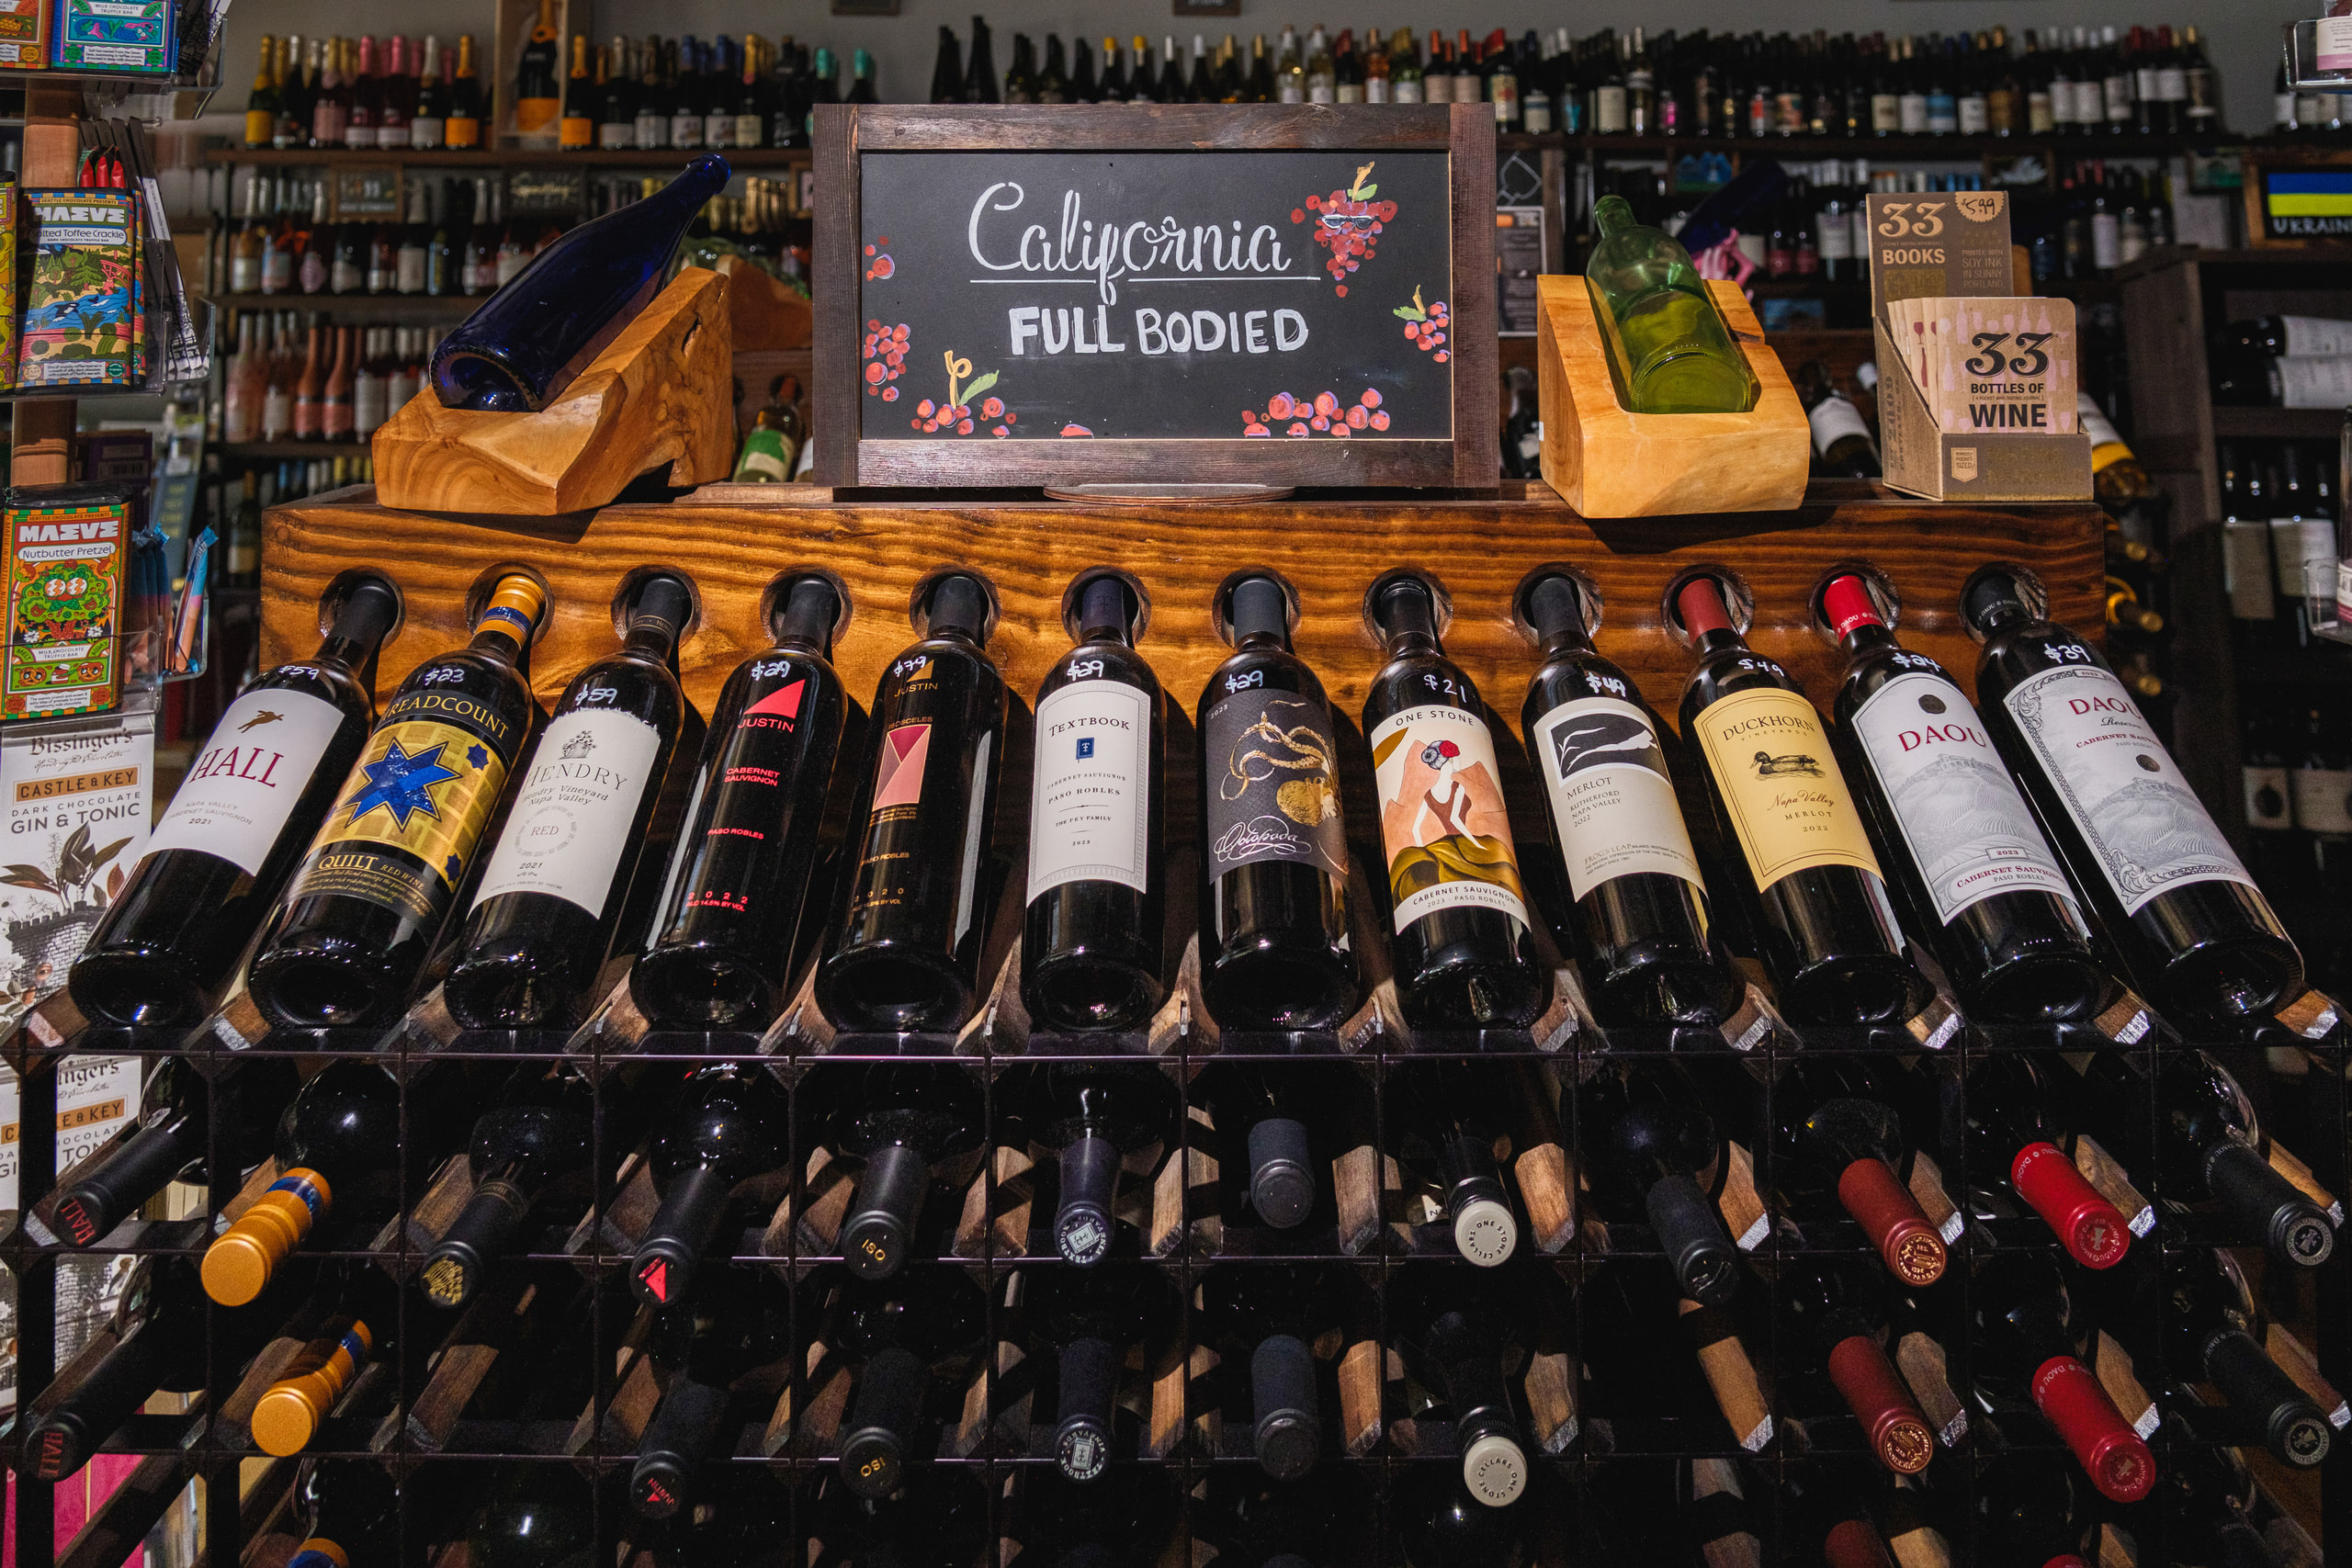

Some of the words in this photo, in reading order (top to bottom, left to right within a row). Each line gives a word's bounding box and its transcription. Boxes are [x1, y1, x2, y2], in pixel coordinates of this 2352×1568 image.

[34, 207, 124, 223] MAEVE
[1878, 202, 1949, 238] 33
[63, 229, 91, 237] Toffee
[93, 229, 124, 239] Crackle
[2273, 217, 2352, 234] UKRAIN
[968, 182, 1291, 305] California
[1883, 249, 1945, 265] BOOKS
[1962, 258, 1982, 268] SOY
[1984, 257, 2002, 266] INK
[1963, 270, 1972, 278] IN
[1974, 269, 2003, 278] SUNNY
[1009, 305, 1125, 355] FULL
[1136, 308, 1309, 355] BODIED
[1965, 332, 2054, 378] 33
[1971, 383, 2025, 394] BOTTLES
[2029, 383, 2044, 394] OF
[1969, 404, 2047, 427] WINE
[19, 521, 119, 542] MAEVE
[23, 548, 74, 558] Nutbutter
[77, 546, 111, 556] Pretzel
[17, 648, 31, 660] MELT
[2043, 643, 2091, 664] $39
[278, 665, 320, 680] $59
[751, 660, 791, 681] $29
[1067, 660, 1104, 681] $29
[894, 682, 938, 697] JUSTIN
[1225, 670, 1264, 694] $29
[1586, 671, 1626, 697] $49
[574, 683, 618, 705] $59
[1210, 704, 1229, 719] 2023
[2068, 696, 2142, 719] DAOU
[737, 718, 795, 733] JUSTIN
[888, 716, 933, 730] ISOSCELES
[1048, 717, 1131, 738] TEXTBOOK
[1396, 711, 1424, 727] ONE
[1430, 711, 1475, 727] STONE
[1723, 716, 1815, 741] DUCKHORN
[29, 727, 133, 756] Bissinger's
[1740, 728, 1808, 741] VINEYARDS
[1897, 724, 1988, 752] DAOU
[2076, 733, 2127, 748] CABERNET
[188, 746, 284, 788] HALL
[726, 766, 781, 779] CABERNET
[20, 777, 86, 799] CASTLE
[91, 778, 98, 787] &
[103, 771, 134, 787] KEY
[523, 763, 628, 794] HENDRY
[724, 775, 779, 786] SAUVIGNON
[1566, 776, 1612, 800] MERLOT
[523, 785, 555, 801] Hendry
[560, 784, 609, 802] Vineyard
[528, 795, 552, 807] Napa
[559, 794, 592, 806] Valley
[1047, 791, 1072, 804] PASO
[1077, 787, 1121, 795] ROBLES
[1569, 790, 1620, 811] RUTHERFORD
[1767, 792, 1798, 811] Napa
[1798, 789, 1835, 807] Valley
[12, 806, 49, 817] DARK
[58, 792, 141, 810] CHOCOLATE
[1572, 807, 1592, 819] NAPA
[1593, 797, 1622, 809] VALLEY
[11, 817, 48, 834] GIN
[56, 814, 69, 827] &
[77, 803, 141, 824] TONIC
[1574, 815, 1591, 827] 2022
[1785, 810, 1832, 821] MERLOT
[530, 825, 560, 837] RED
[707, 828, 730, 836] PASO
[730, 828, 764, 840] ROBLES
[880, 852, 910, 861] ROBLES
[1611, 843, 1632, 853] LEAP
[319, 855, 379, 870] QUILT
[380, 864, 401, 877] RED
[401, 874, 425, 890] WINE
[519, 862, 543, 870] 2021
[1957, 866, 2012, 888] CABERNET
[1413, 886, 1459, 905] CABERNET
[1464, 886, 1516, 905] SAUVIGNON
[1427, 897, 1445, 908] 2023
[1478, 897, 1507, 907] ROBLES
[732, 903, 745, 912] VOL
[89, 1102, 121, 1121] KEY
[60, 1197, 96, 1246] HALL
[1476, 1220, 1495, 1228] ONE
[862, 1238, 886, 1261] ISO
[1468, 1231, 1493, 1259] CELLARS
[1497, 1225, 1507, 1255] STONE
[2042, 1365, 2066, 1385] DAOU
[38, 1432, 64, 1479] HALL
[1478, 1458, 1512, 1477] CELLARS
[1479, 1481, 1507, 1499] STONE
[1508, 1472, 1518, 1492] ONE
